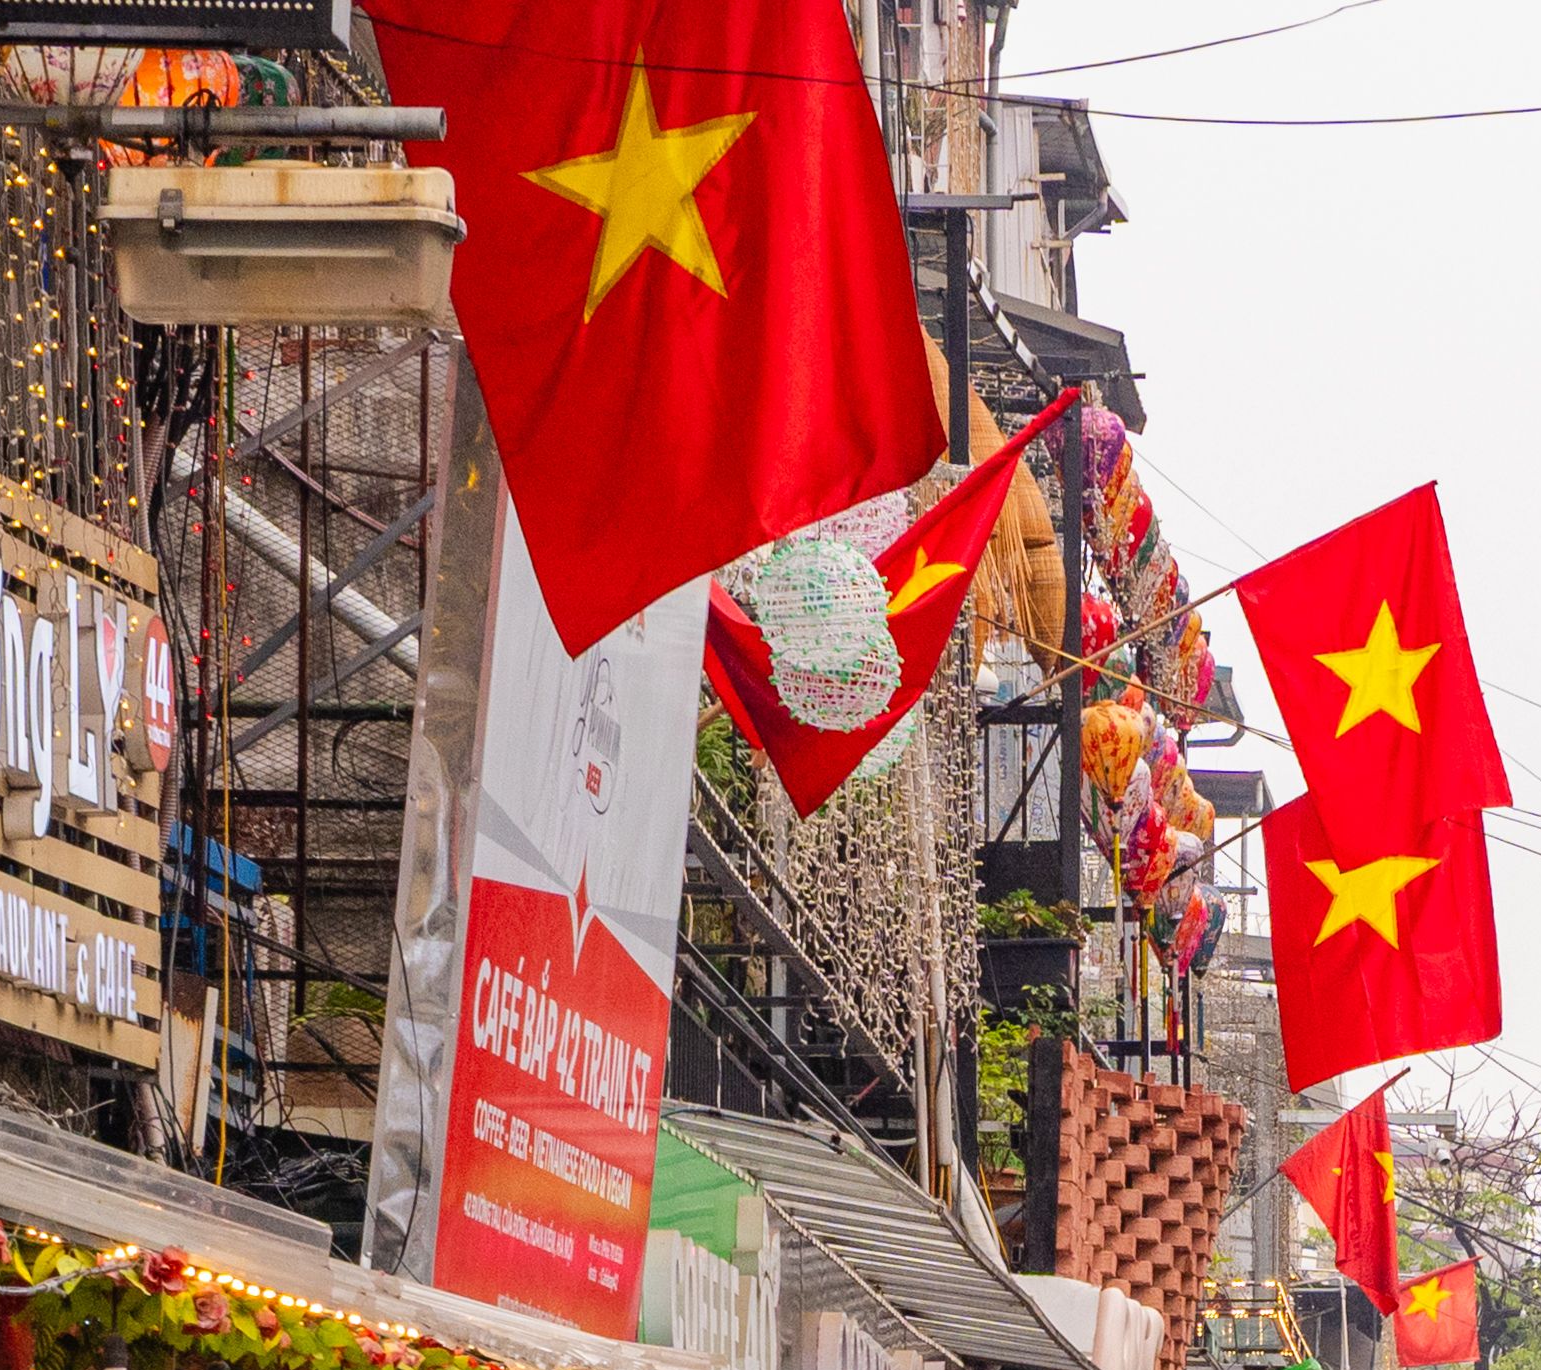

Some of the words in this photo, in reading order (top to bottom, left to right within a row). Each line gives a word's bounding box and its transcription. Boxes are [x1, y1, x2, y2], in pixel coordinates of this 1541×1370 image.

[145, 637, 171, 725] 44
[76, 943, 90, 1004] &
[95, 932, 139, 1023] CAFE
[473, 956, 525, 1065] CAFÉ
[519, 959, 559, 1082] BẮP
[556, 1008, 581, 1097] 42
[580, 1018, 631, 1123] TRAIN
[627, 1047, 652, 1136] ST.
[473, 1098, 507, 1150] COFFEE
[508, 1115, 530, 1161] BEER
[533, 1127, 580, 1186] VIETNAMESE
[578, 1150, 601, 1194] FOOD
[607, 1164, 633, 1211] VEGAN
